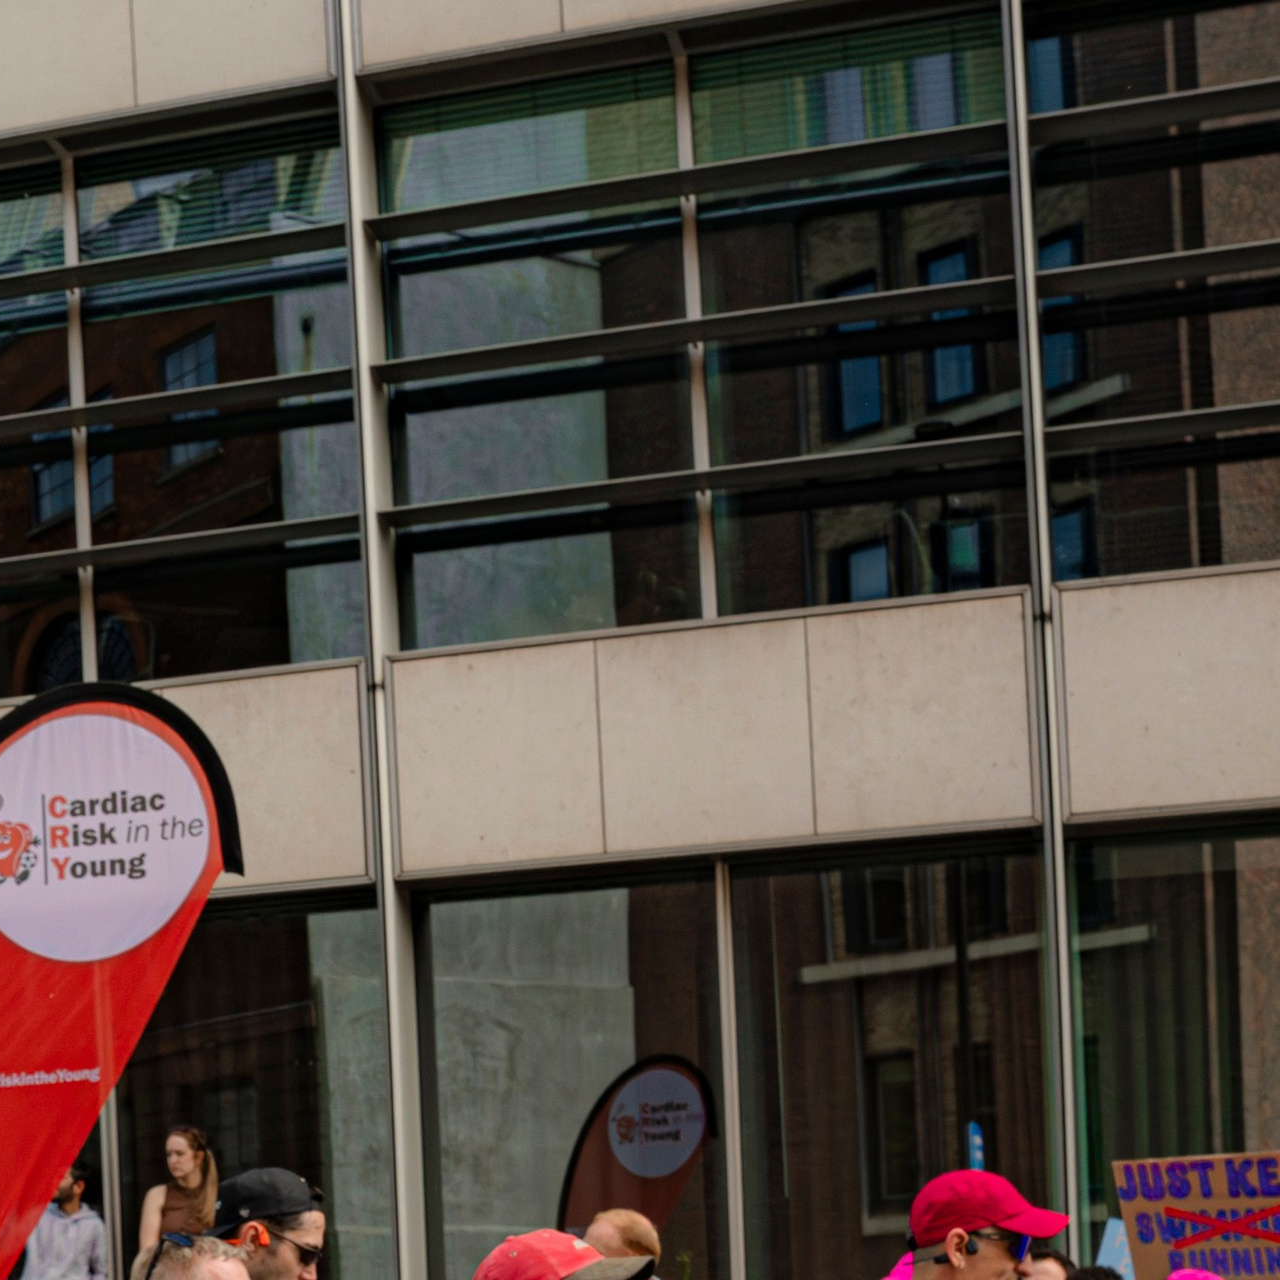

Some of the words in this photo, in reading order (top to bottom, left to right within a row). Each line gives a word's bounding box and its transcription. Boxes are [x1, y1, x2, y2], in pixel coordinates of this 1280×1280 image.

[48, 790, 166, 819] Cardiac
[49, 822, 117, 849] Risk
[125, 819, 150, 844] in
[160, 815, 204, 841] the
[51, 853, 147, 880] Young
[1118, 1161, 1215, 1202] JUST
